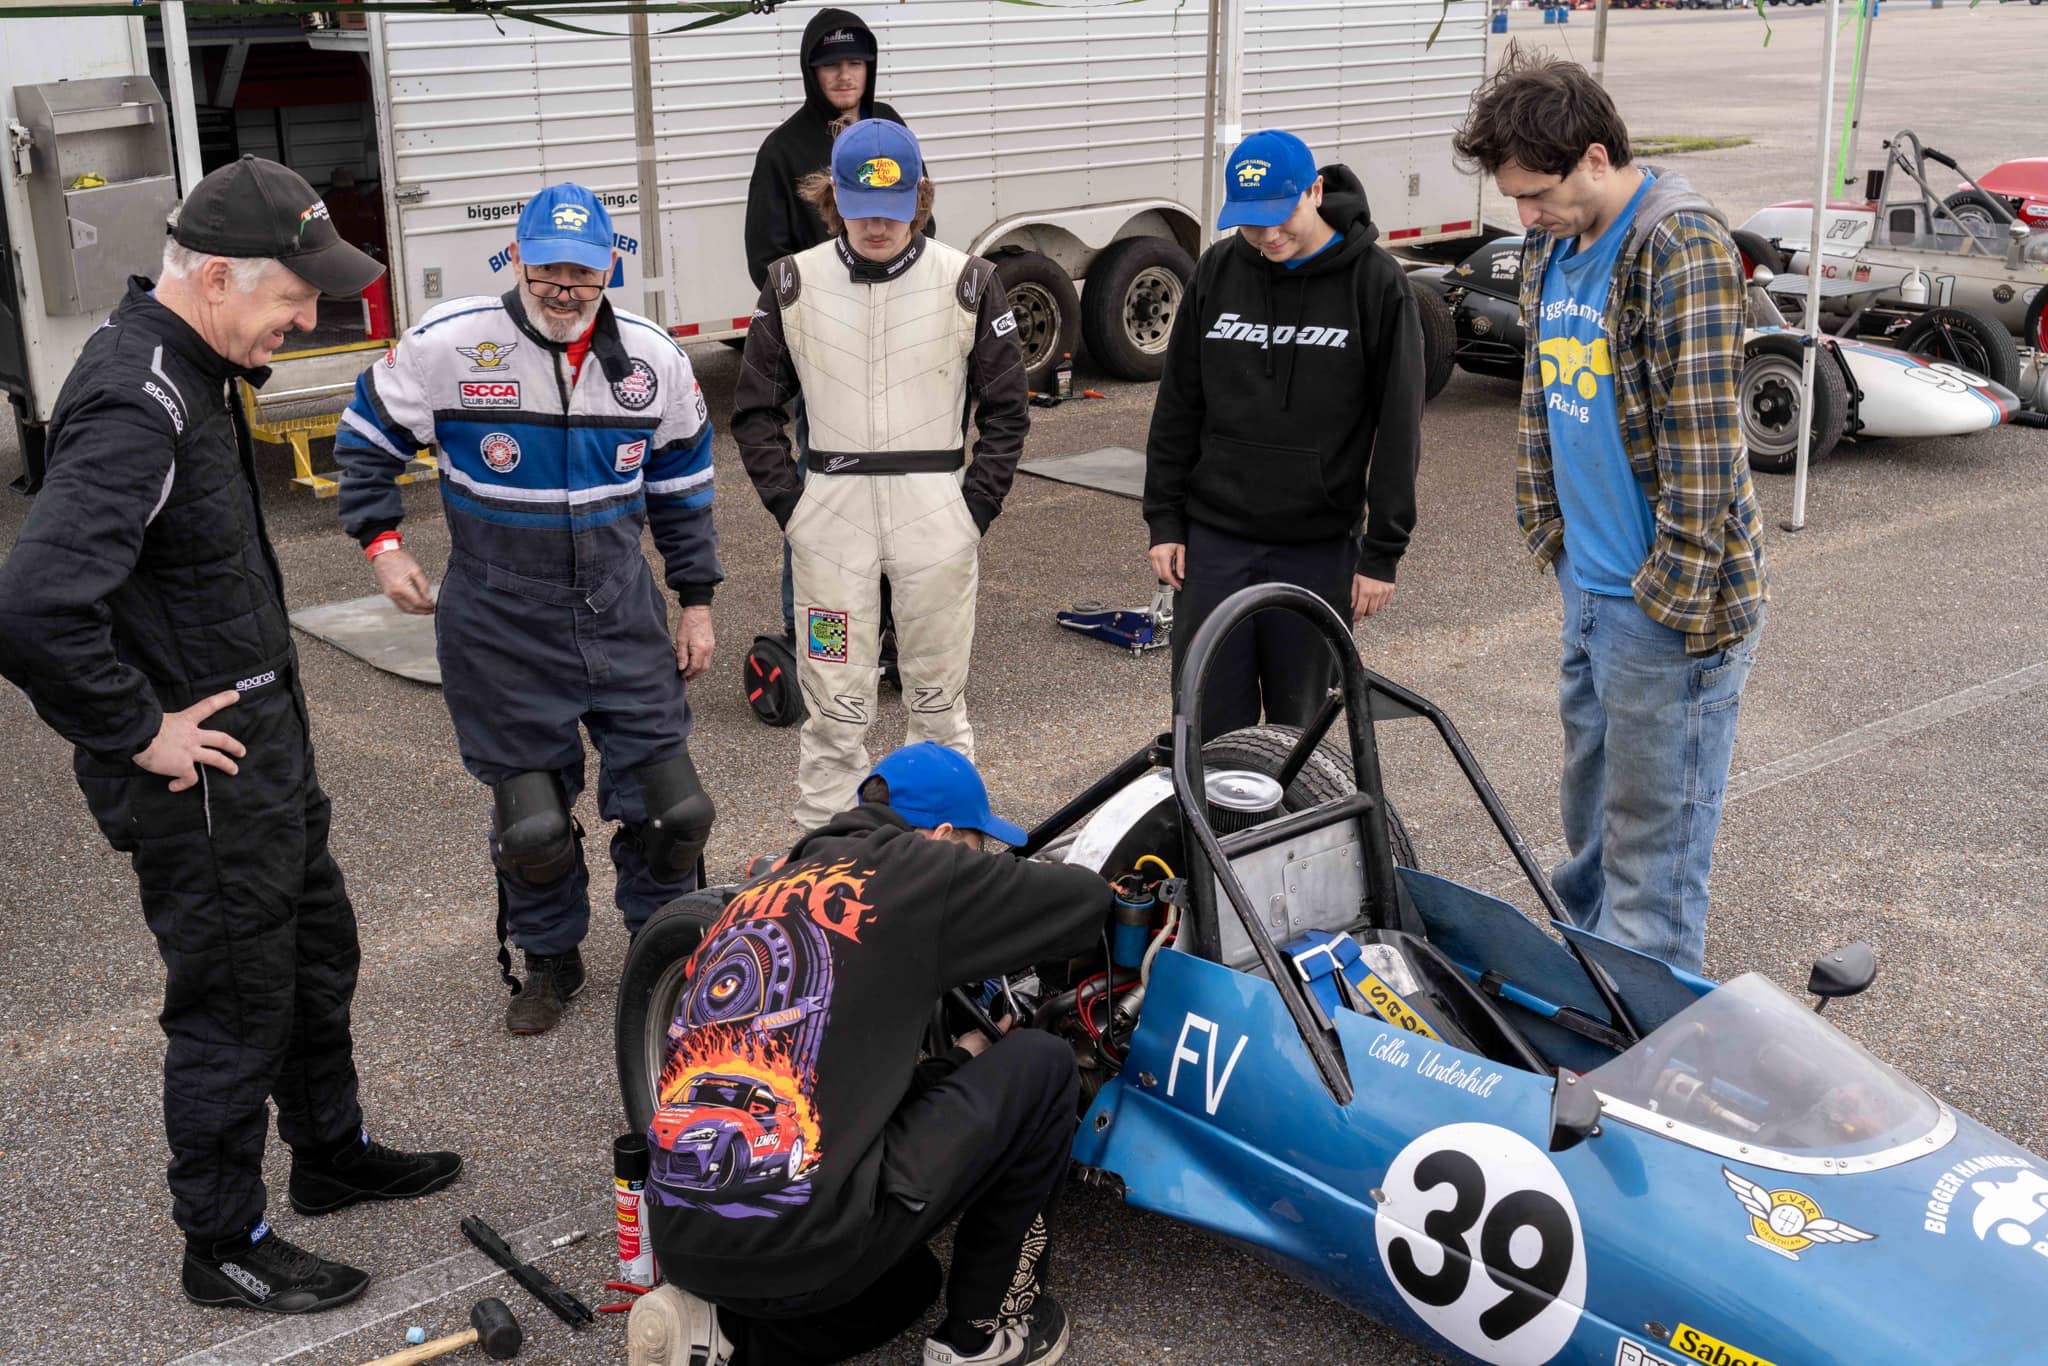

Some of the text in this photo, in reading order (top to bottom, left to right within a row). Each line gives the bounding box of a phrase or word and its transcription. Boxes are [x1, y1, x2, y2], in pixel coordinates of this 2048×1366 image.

[468, 202, 525, 220] biggerh
[1826, 219, 1868, 240] FV
[463, 384, 516, 397] SCCA
[141, 381, 183, 435] sparco
[236, 670, 276, 691] sparco
[1166, 1011, 1249, 1115] FV
[1368, 1033, 1503, 1098] Collin Underhill
[1777, 1193, 1816, 1216] CVAR
[1924, 1172, 1965, 1235] BIGGER
[1387, 1149, 1575, 1341] 39
[1758, 1221, 1801, 1246] CORINTHIAN
